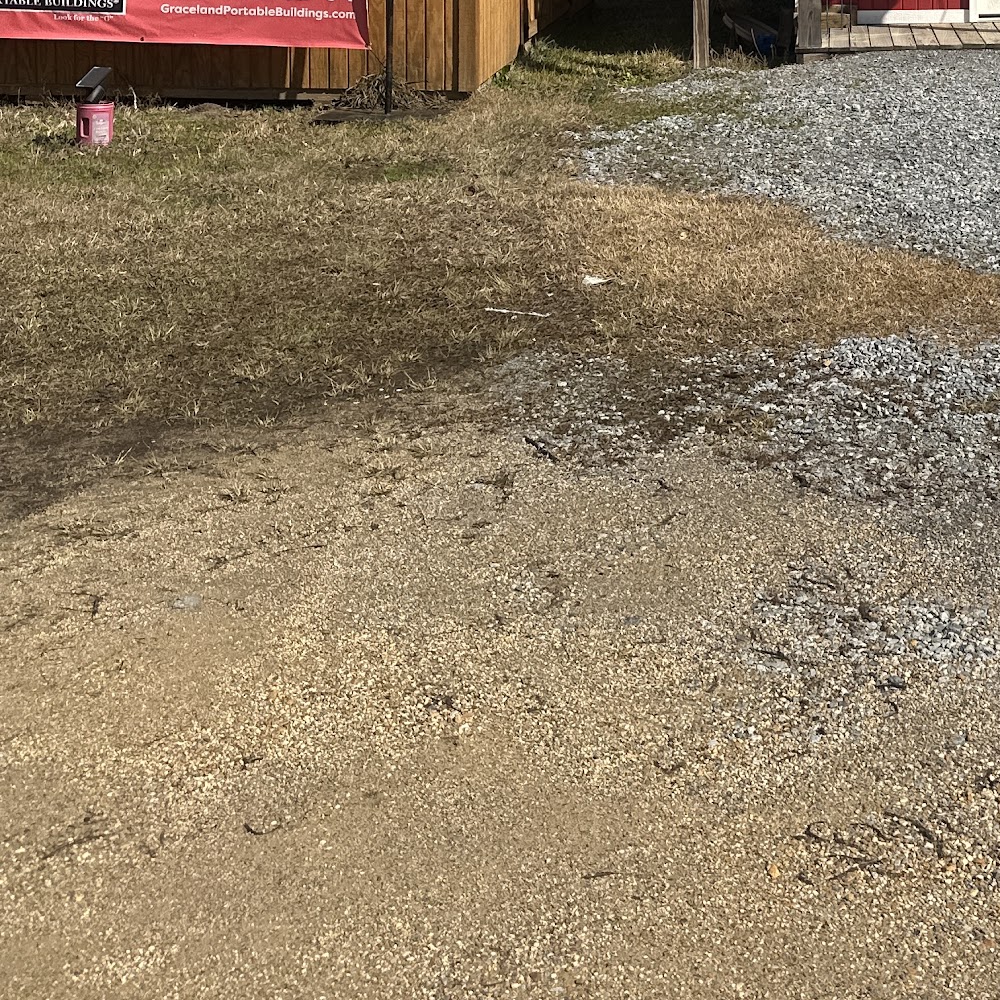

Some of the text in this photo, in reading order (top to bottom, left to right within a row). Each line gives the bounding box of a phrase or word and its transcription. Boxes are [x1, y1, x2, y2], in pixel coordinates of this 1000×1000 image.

[53, 13, 72, 21] Look
[73, 13, 85, 21] for
[86, 13, 99, 22] the
[160, 3, 356, 21] GracelandPortableBuildings.com
